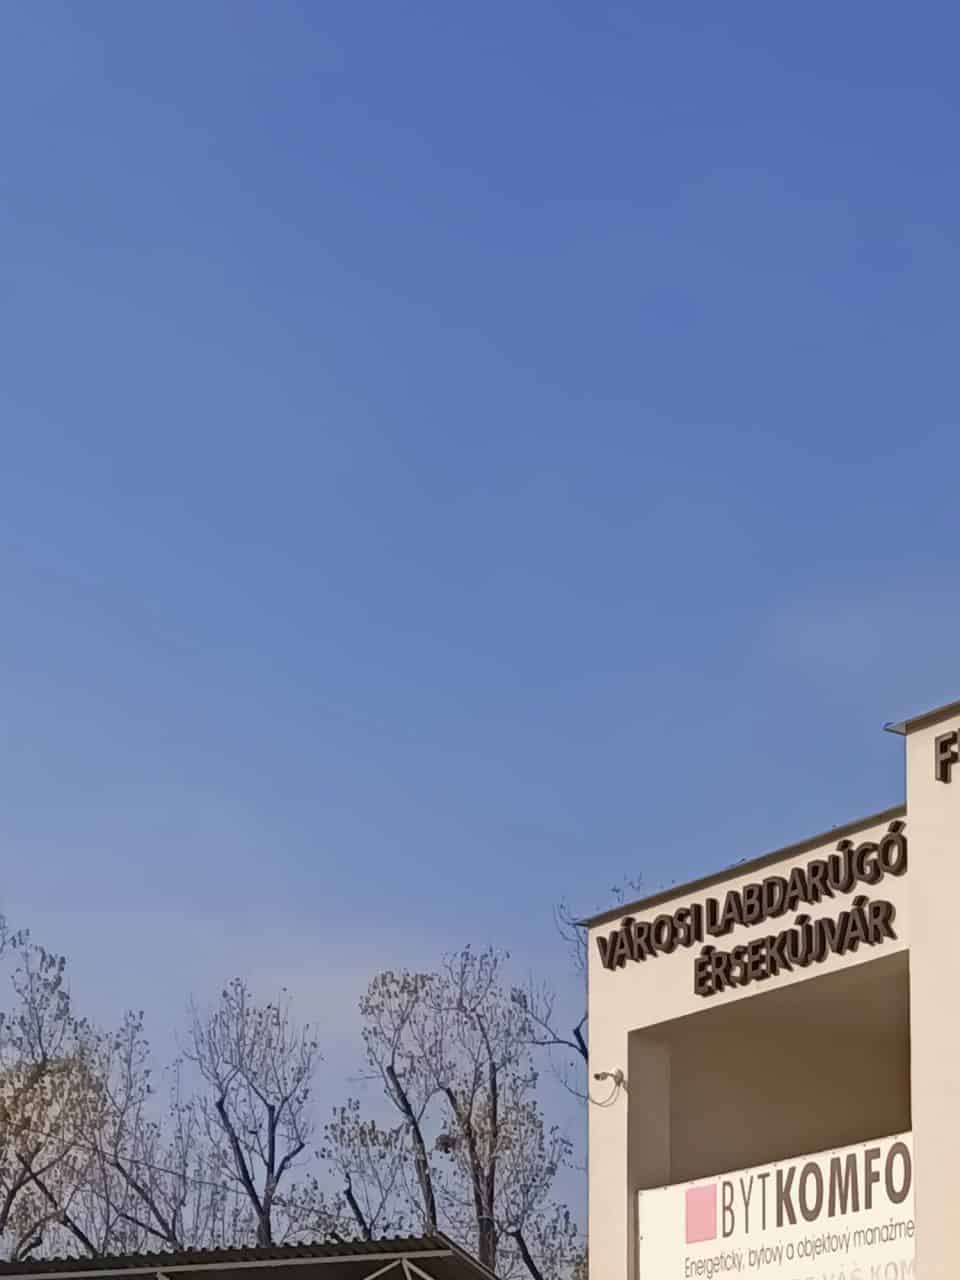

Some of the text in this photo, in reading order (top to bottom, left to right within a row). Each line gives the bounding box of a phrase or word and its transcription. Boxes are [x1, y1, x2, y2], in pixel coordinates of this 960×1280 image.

[596, 820, 908, 971] VÁROSI LABDARÚGÓ
[694, 895, 898, 998] ÉRSEKÚJVÁR
[721, 1140, 913, 1239] BYTKOMFO
[797, 1226, 851, 1260] objektový
